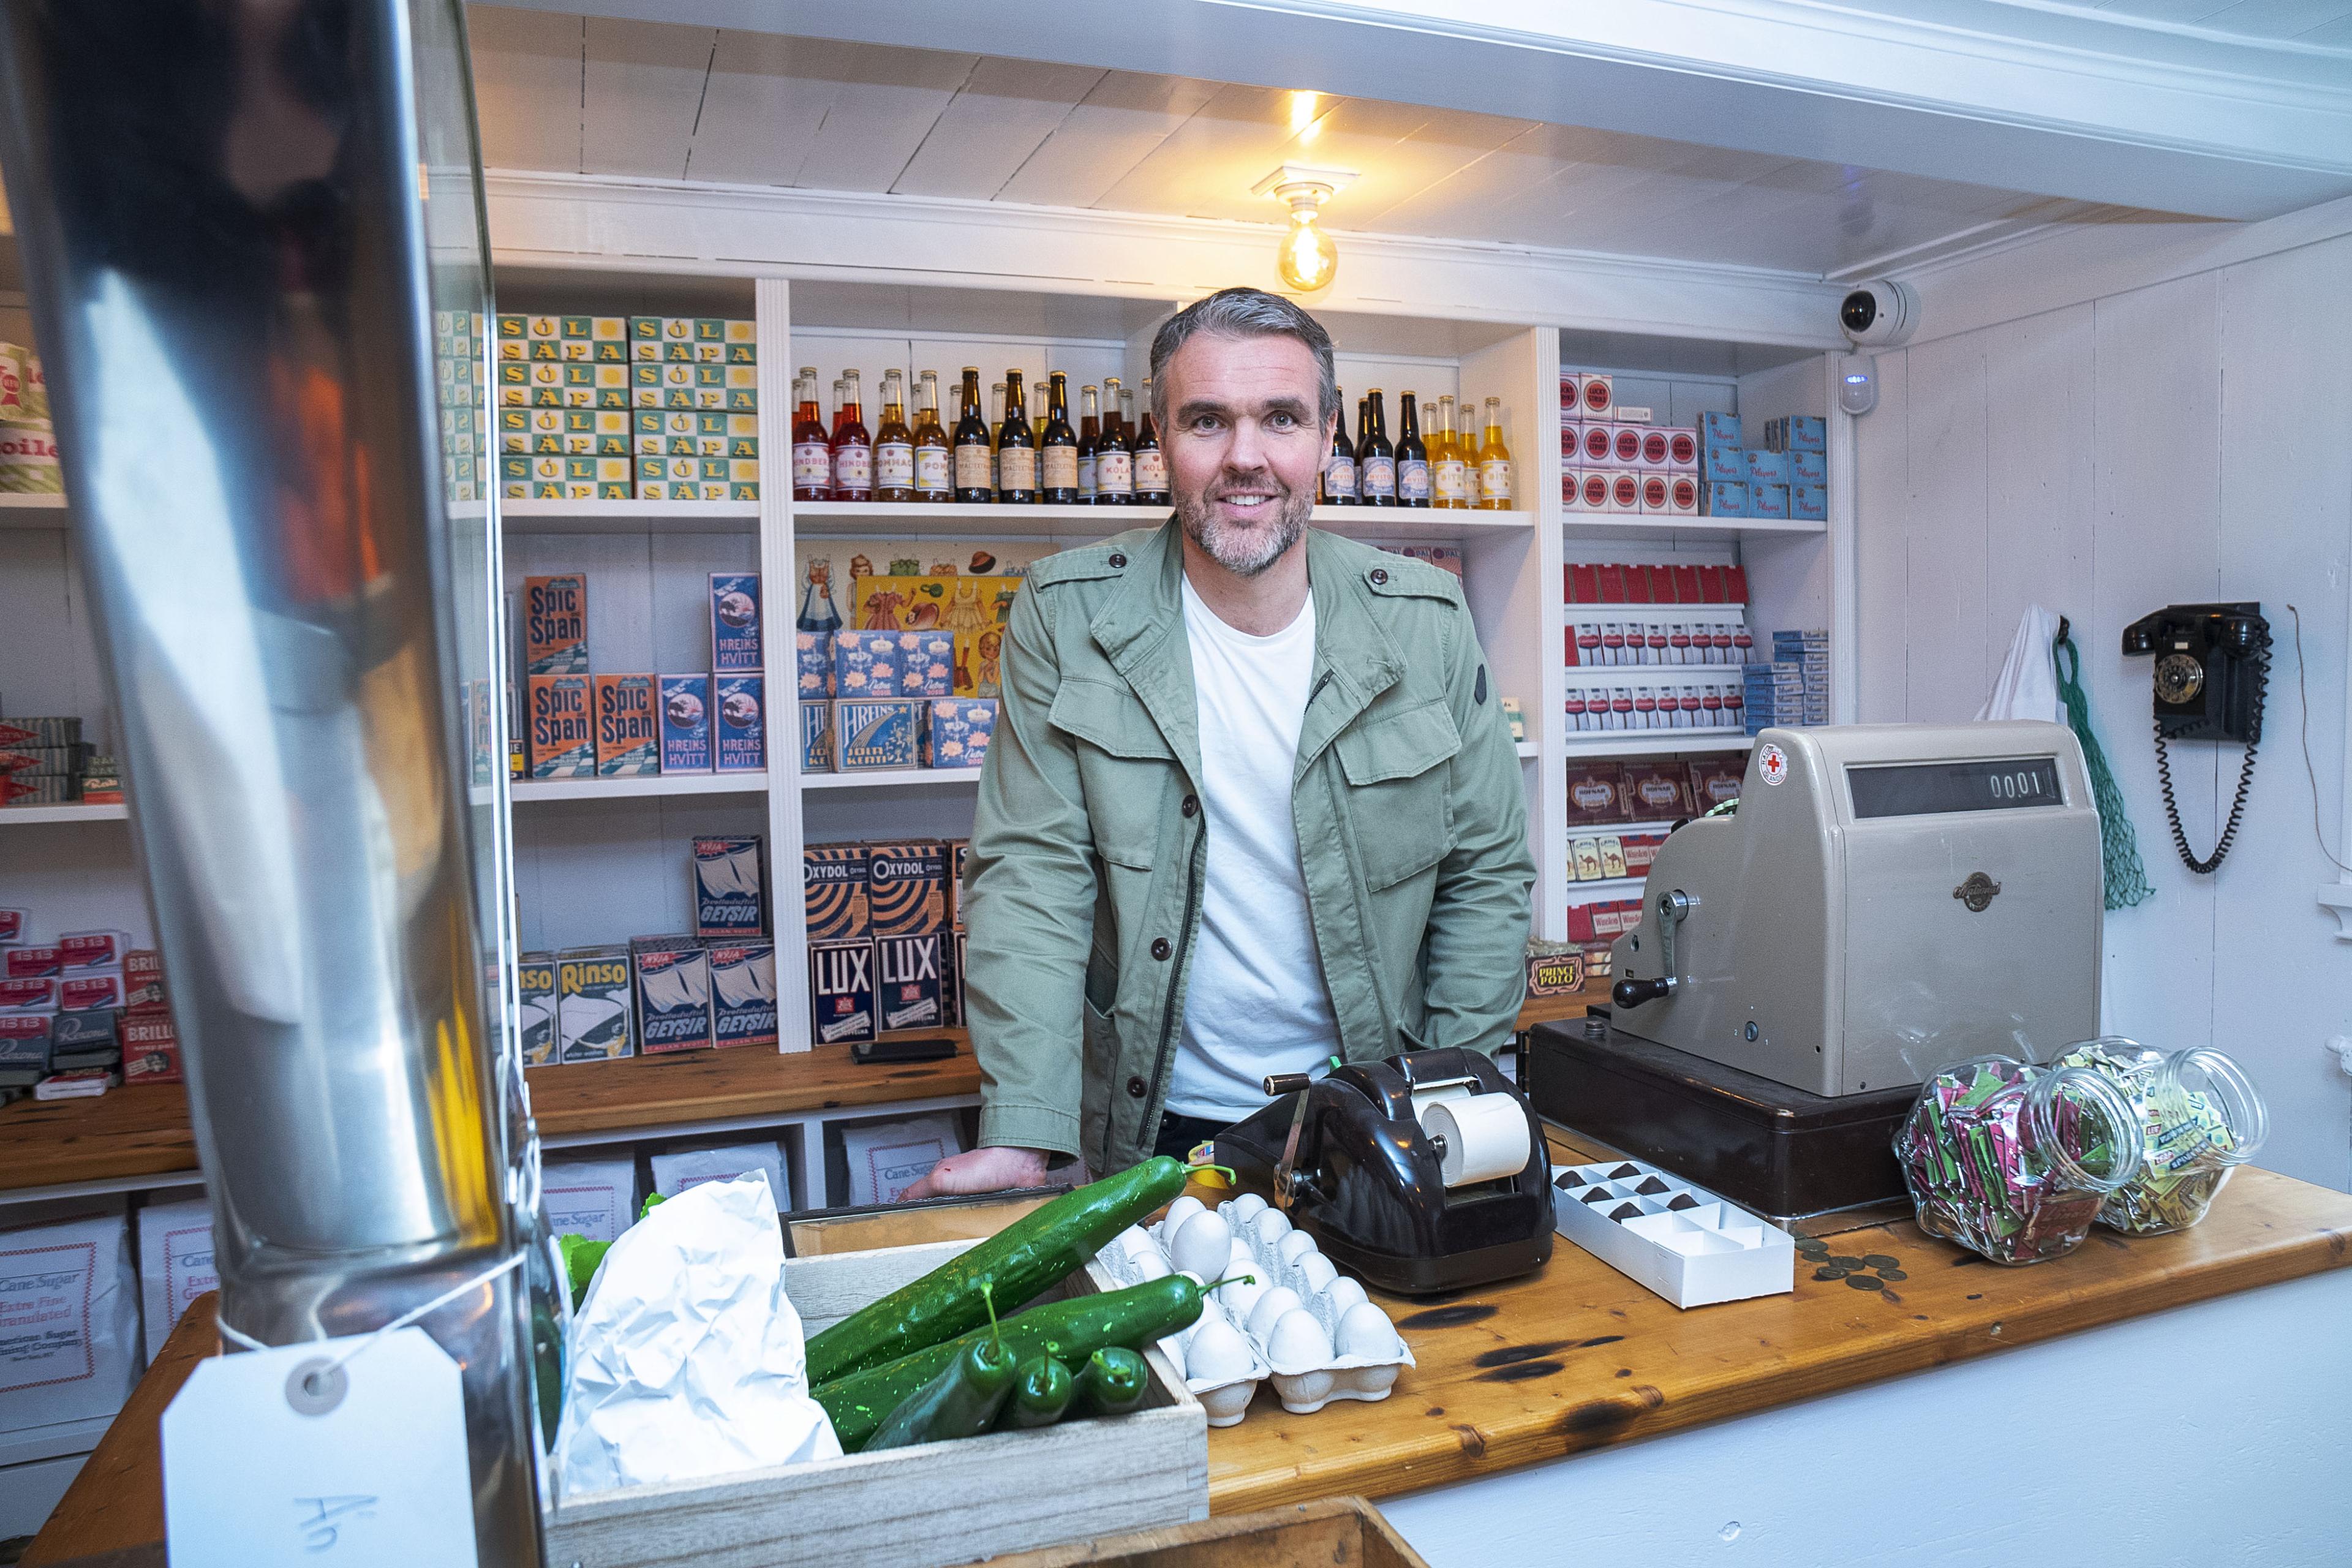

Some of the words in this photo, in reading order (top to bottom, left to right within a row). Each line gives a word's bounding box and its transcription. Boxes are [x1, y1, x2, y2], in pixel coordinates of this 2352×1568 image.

[530, 586, 576, 617] Spic
[530, 616, 581, 645] Span
[535, 686, 582, 718] Spic
[601, 685, 647, 717] Spic
[535, 716, 587, 746] Span
[601, 715, 652, 744] Span
[873, 860, 924, 879] OXYDOL
[701, 906, 758, 922] GEYSIR
[817, 949, 870, 995] LUX
[881, 937, 937, 983] LUX
[1539, 965, 1575, 978] PRINCE
[561, 963, 626, 993] Rinso
[1540, 974, 1573, 986] POLO
[646, 1016, 706, 1038] GEYSIR
[718, 1013, 776, 1035] GEYSIR
[570, 1213, 605, 1227] Sugar
[37, 1273, 80, 1290] Sugar
[0, 1304, 72, 1327] ranulated
